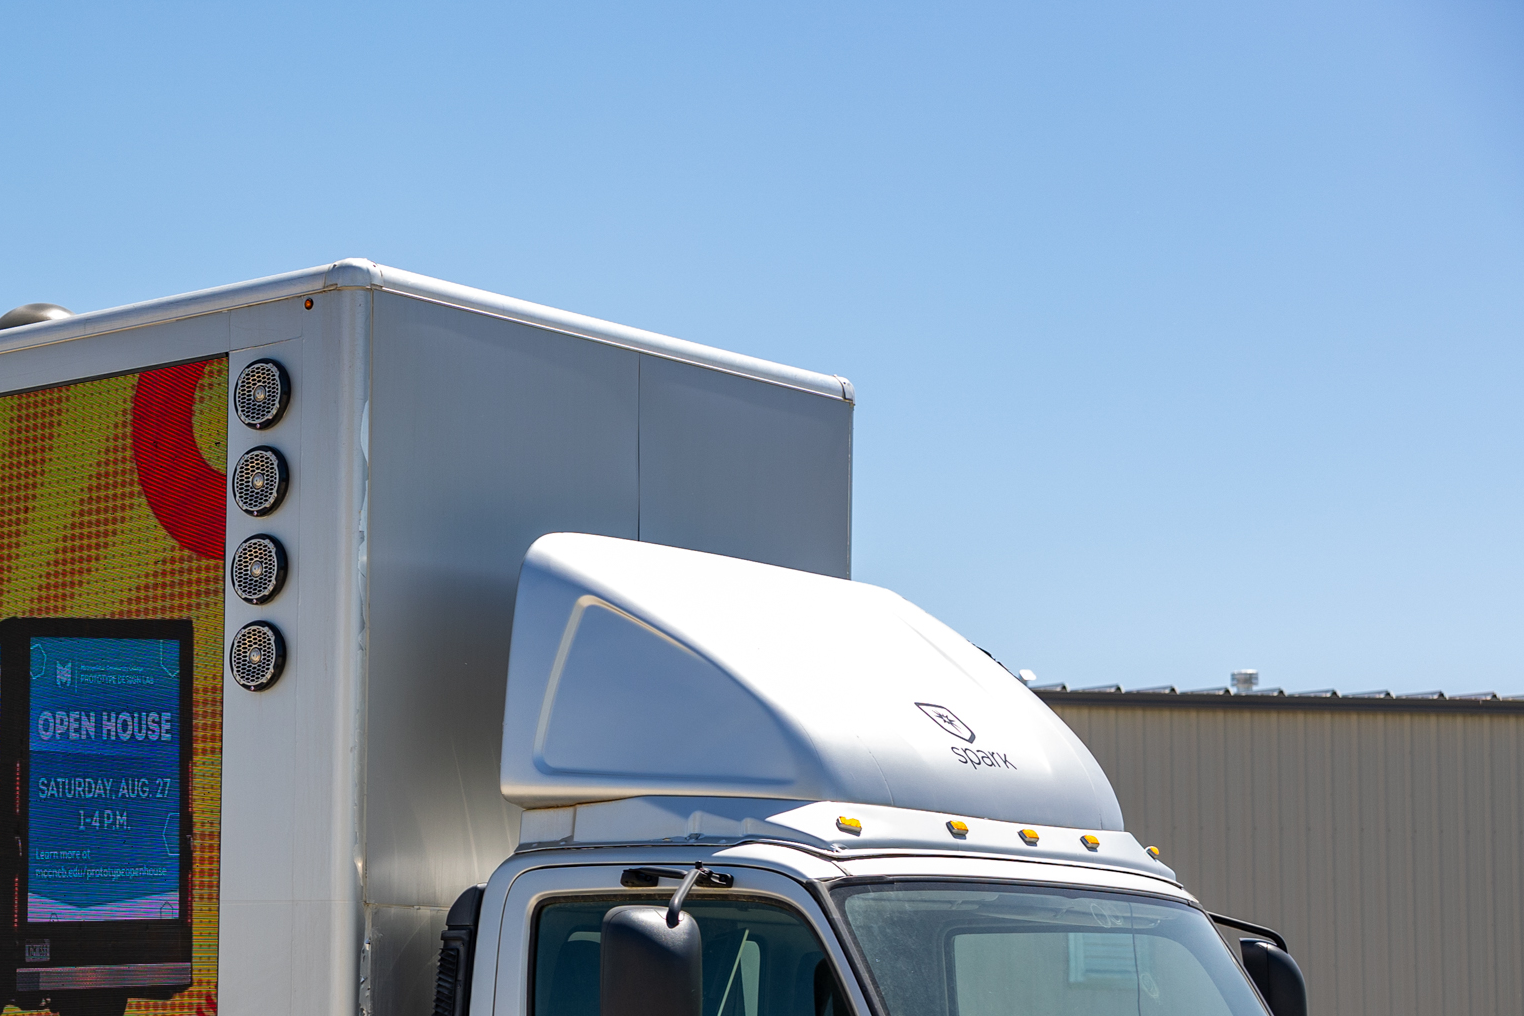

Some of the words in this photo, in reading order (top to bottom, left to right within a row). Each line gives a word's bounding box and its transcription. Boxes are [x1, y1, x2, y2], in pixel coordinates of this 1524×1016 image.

[38, 711, 95, 740] OPEN
[102, 711, 172, 741] HOUSE
[950, 746, 1018, 770] spark
[38, 777, 116, 799] SATURDAY,
[118, 778, 152, 799] AUG.
[156, 779, 171, 798] 27
[78, 810, 100, 831] 1-4
[103, 810, 131, 830] P.M.
[35, 847, 59, 860] Learn
[60, 850, 81, 860] more
[82, 848, 91, 860] at
